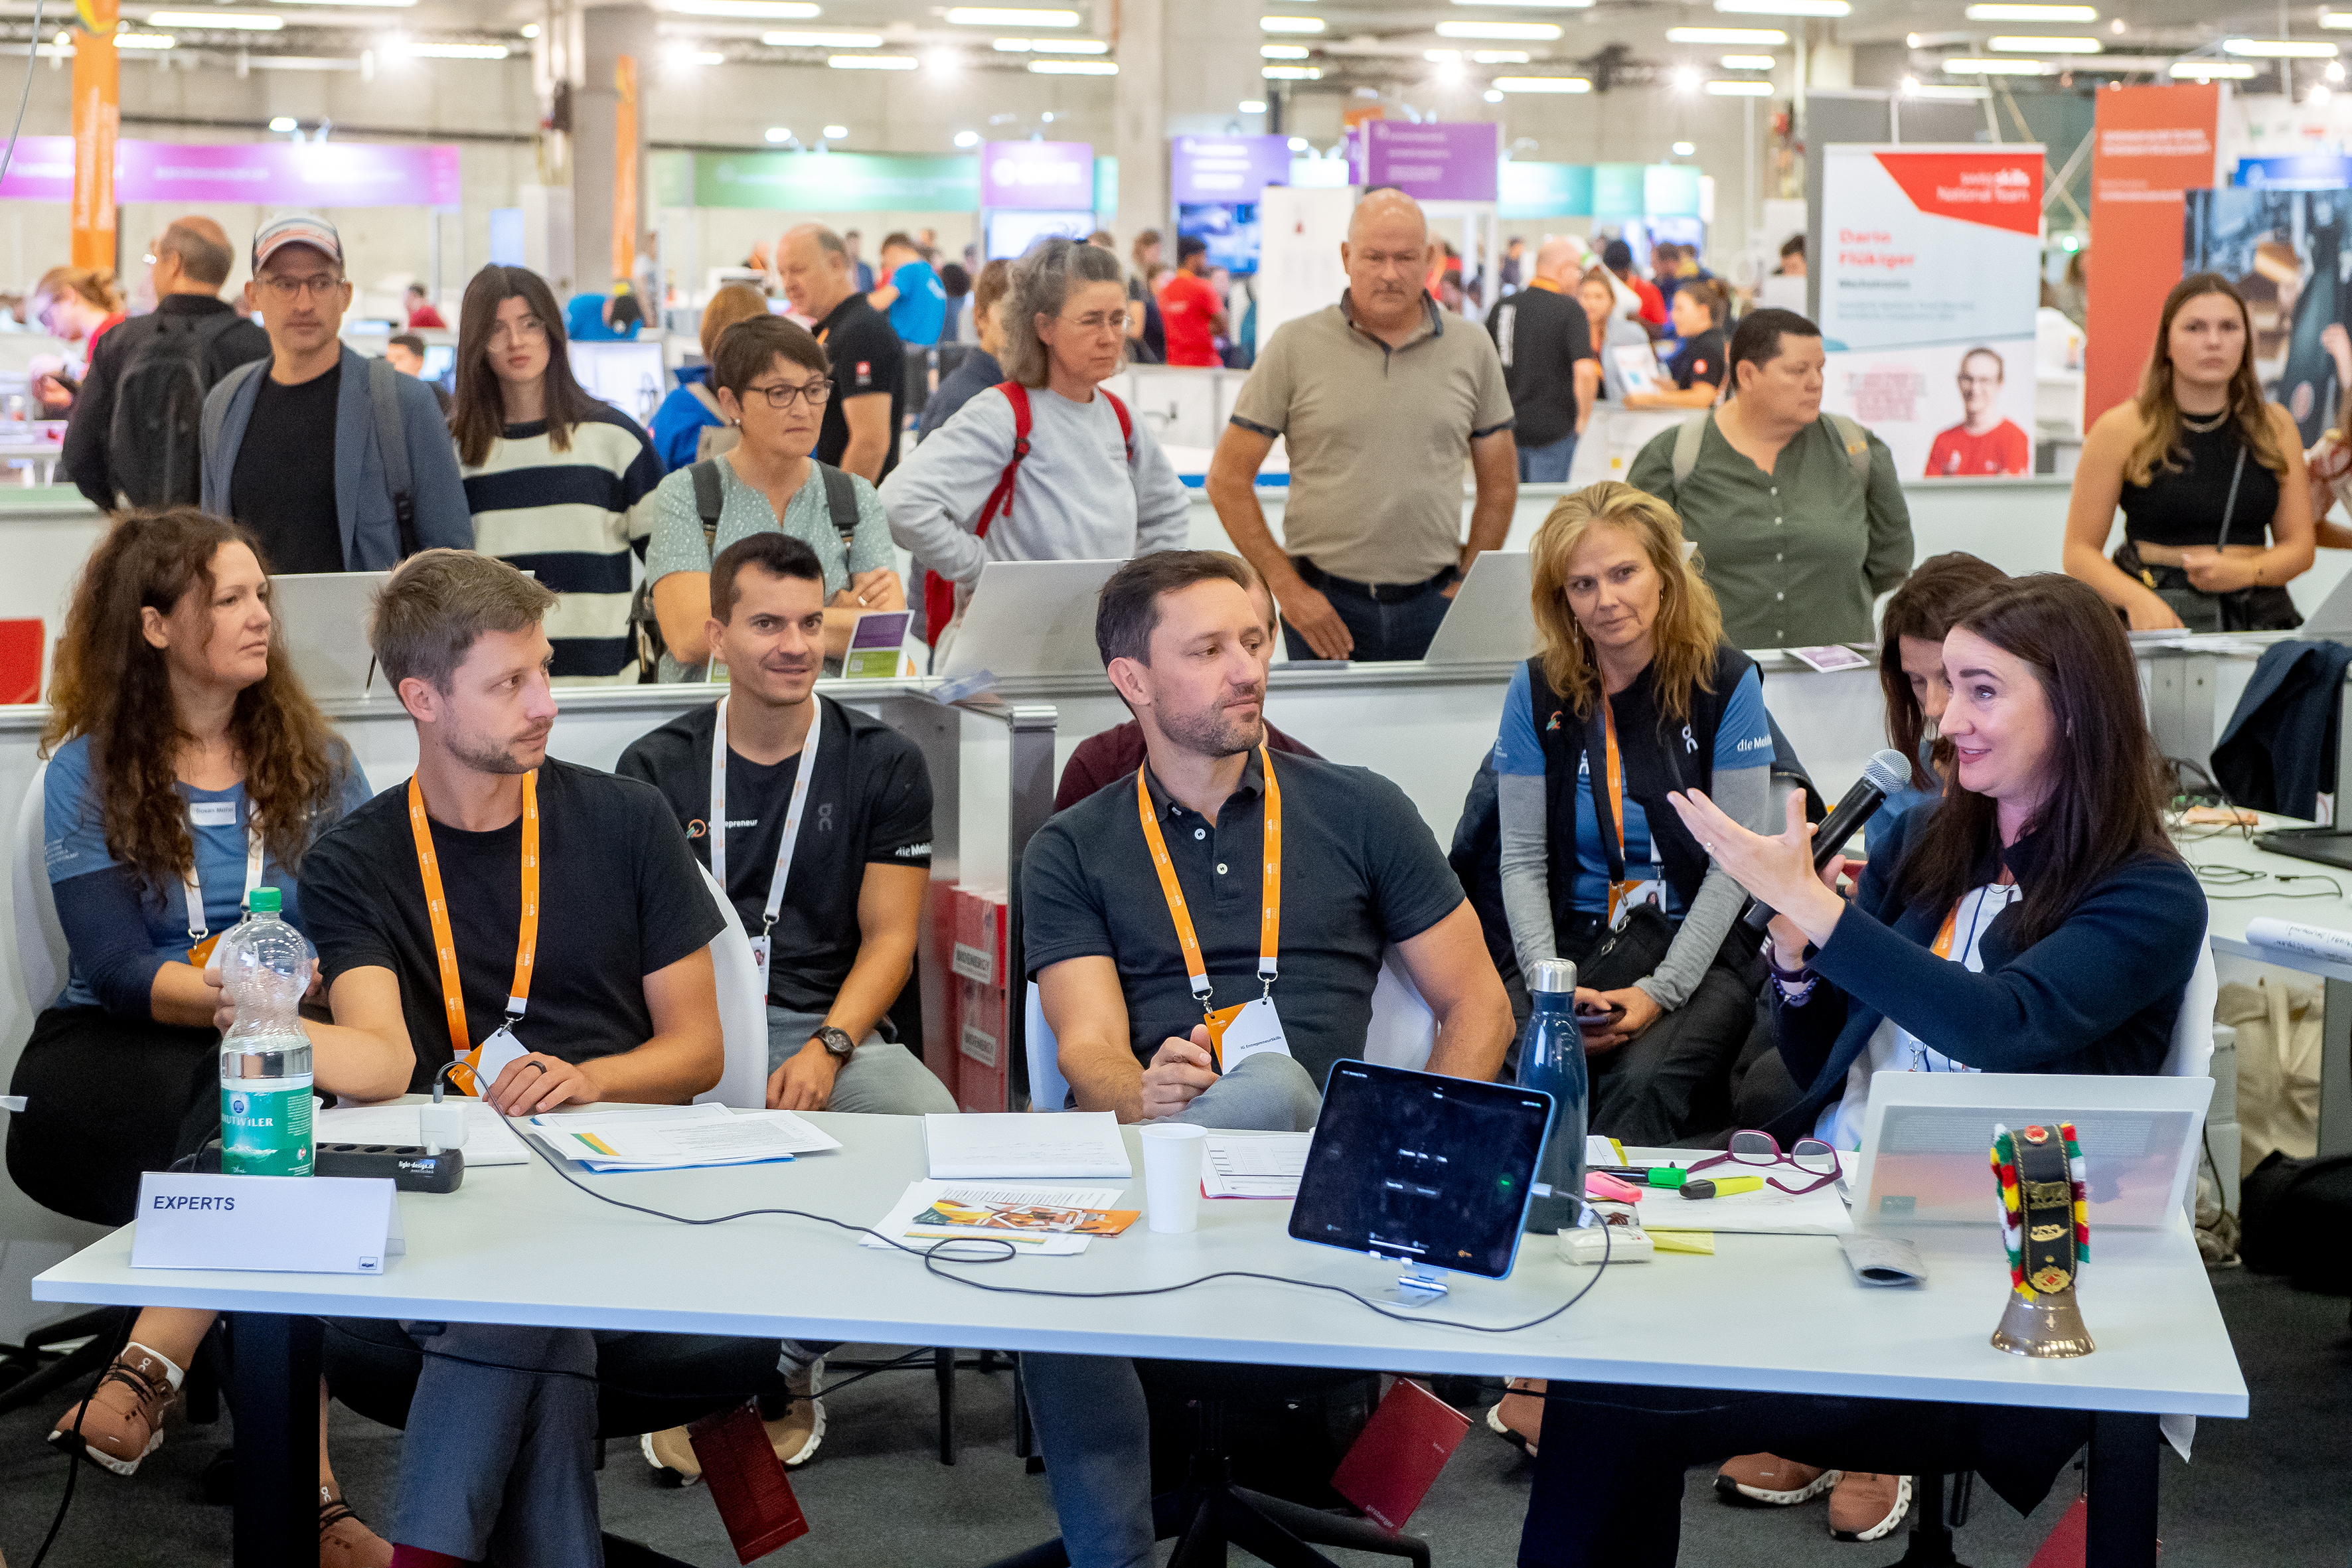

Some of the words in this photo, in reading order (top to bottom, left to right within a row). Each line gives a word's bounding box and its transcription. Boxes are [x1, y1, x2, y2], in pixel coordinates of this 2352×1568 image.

[1737, 739, 1753, 751] die
[1246, 1036, 1282, 1048] EntrepreneurSkills
[399, 1160, 435, 1170] light-design.ch
[153, 1196, 235, 1210] EXPERTS
